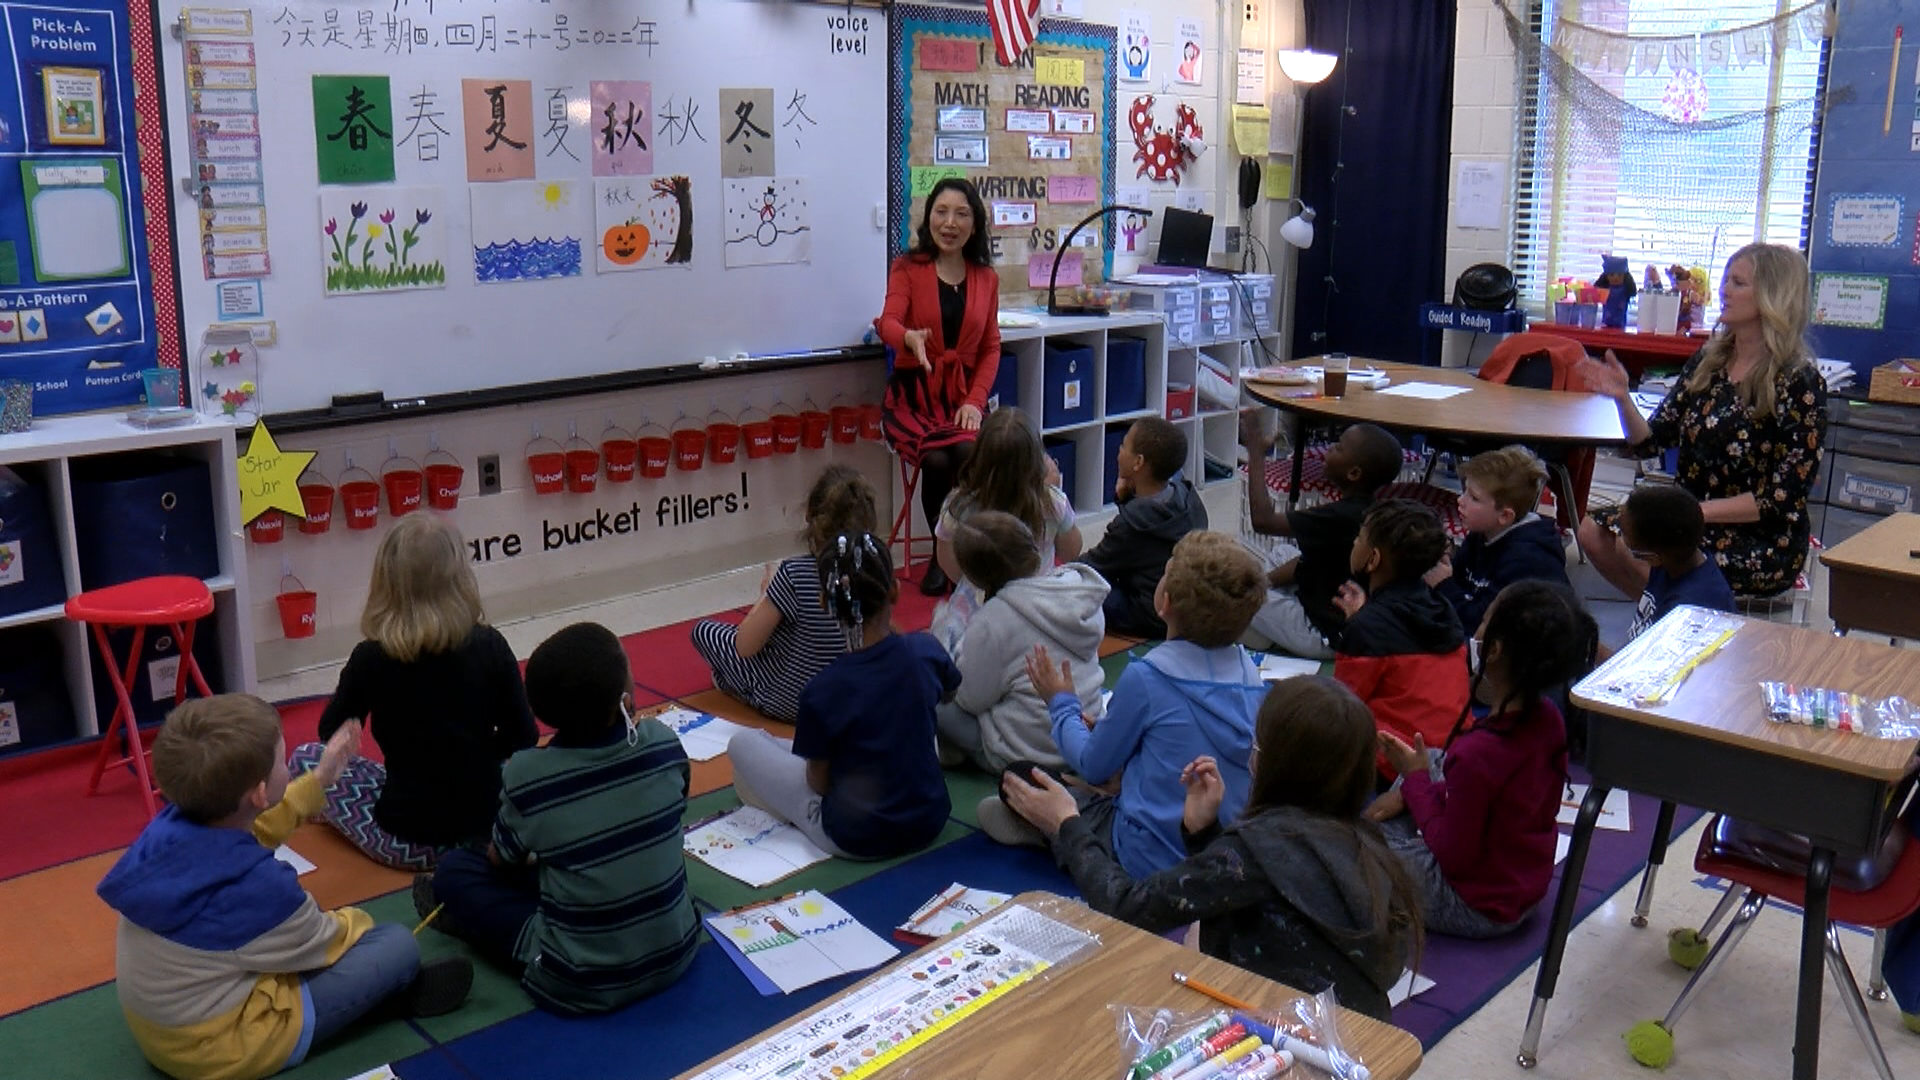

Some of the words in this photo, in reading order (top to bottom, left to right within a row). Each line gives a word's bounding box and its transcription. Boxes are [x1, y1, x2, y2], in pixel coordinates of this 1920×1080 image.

[32, 17, 91, 33] Pick-A-
[827, 16, 868, 32] voice
[31, 34, 97, 51] Problem
[831, 32, 866, 55] level
[979, 42, 985, 65] I
[934, 82, 989, 106] MATH
[1015, 84, 1089, 108] READING
[327, 85, 392, 150] 春
[397, 84, 450, 161] 春
[484, 84, 527, 152] 夏
[543, 87, 581, 163] 夏
[601, 100, 647, 154] 秋
[658, 92, 707, 147] 秋
[726, 100, 771, 153] 冬
[782, 88, 817, 149] 冬
[219, 144, 241, 152] lunch
[221, 191, 250, 201] writing
[975, 176, 1046, 199] WRITING
[1842, 211, 1864, 219] letter
[1868, 202, 1896, 211] capital
[1837, 291, 1861, 300] letters
[1842, 281, 1881, 291] lowercase
[1428, 310, 1453, 325] Guided
[1460, 312, 1492, 333] Reading
[36, 380, 68, 391] School
[85, 375, 120, 386] Pattern
[244, 455, 281, 474] Star
[251, 477, 281, 497] Jar
[1856, 481, 1895, 498] fluency
[467, 533, 522, 561] are
[543, 502, 640, 551] bucket
[656, 472, 750, 528] fillers!
